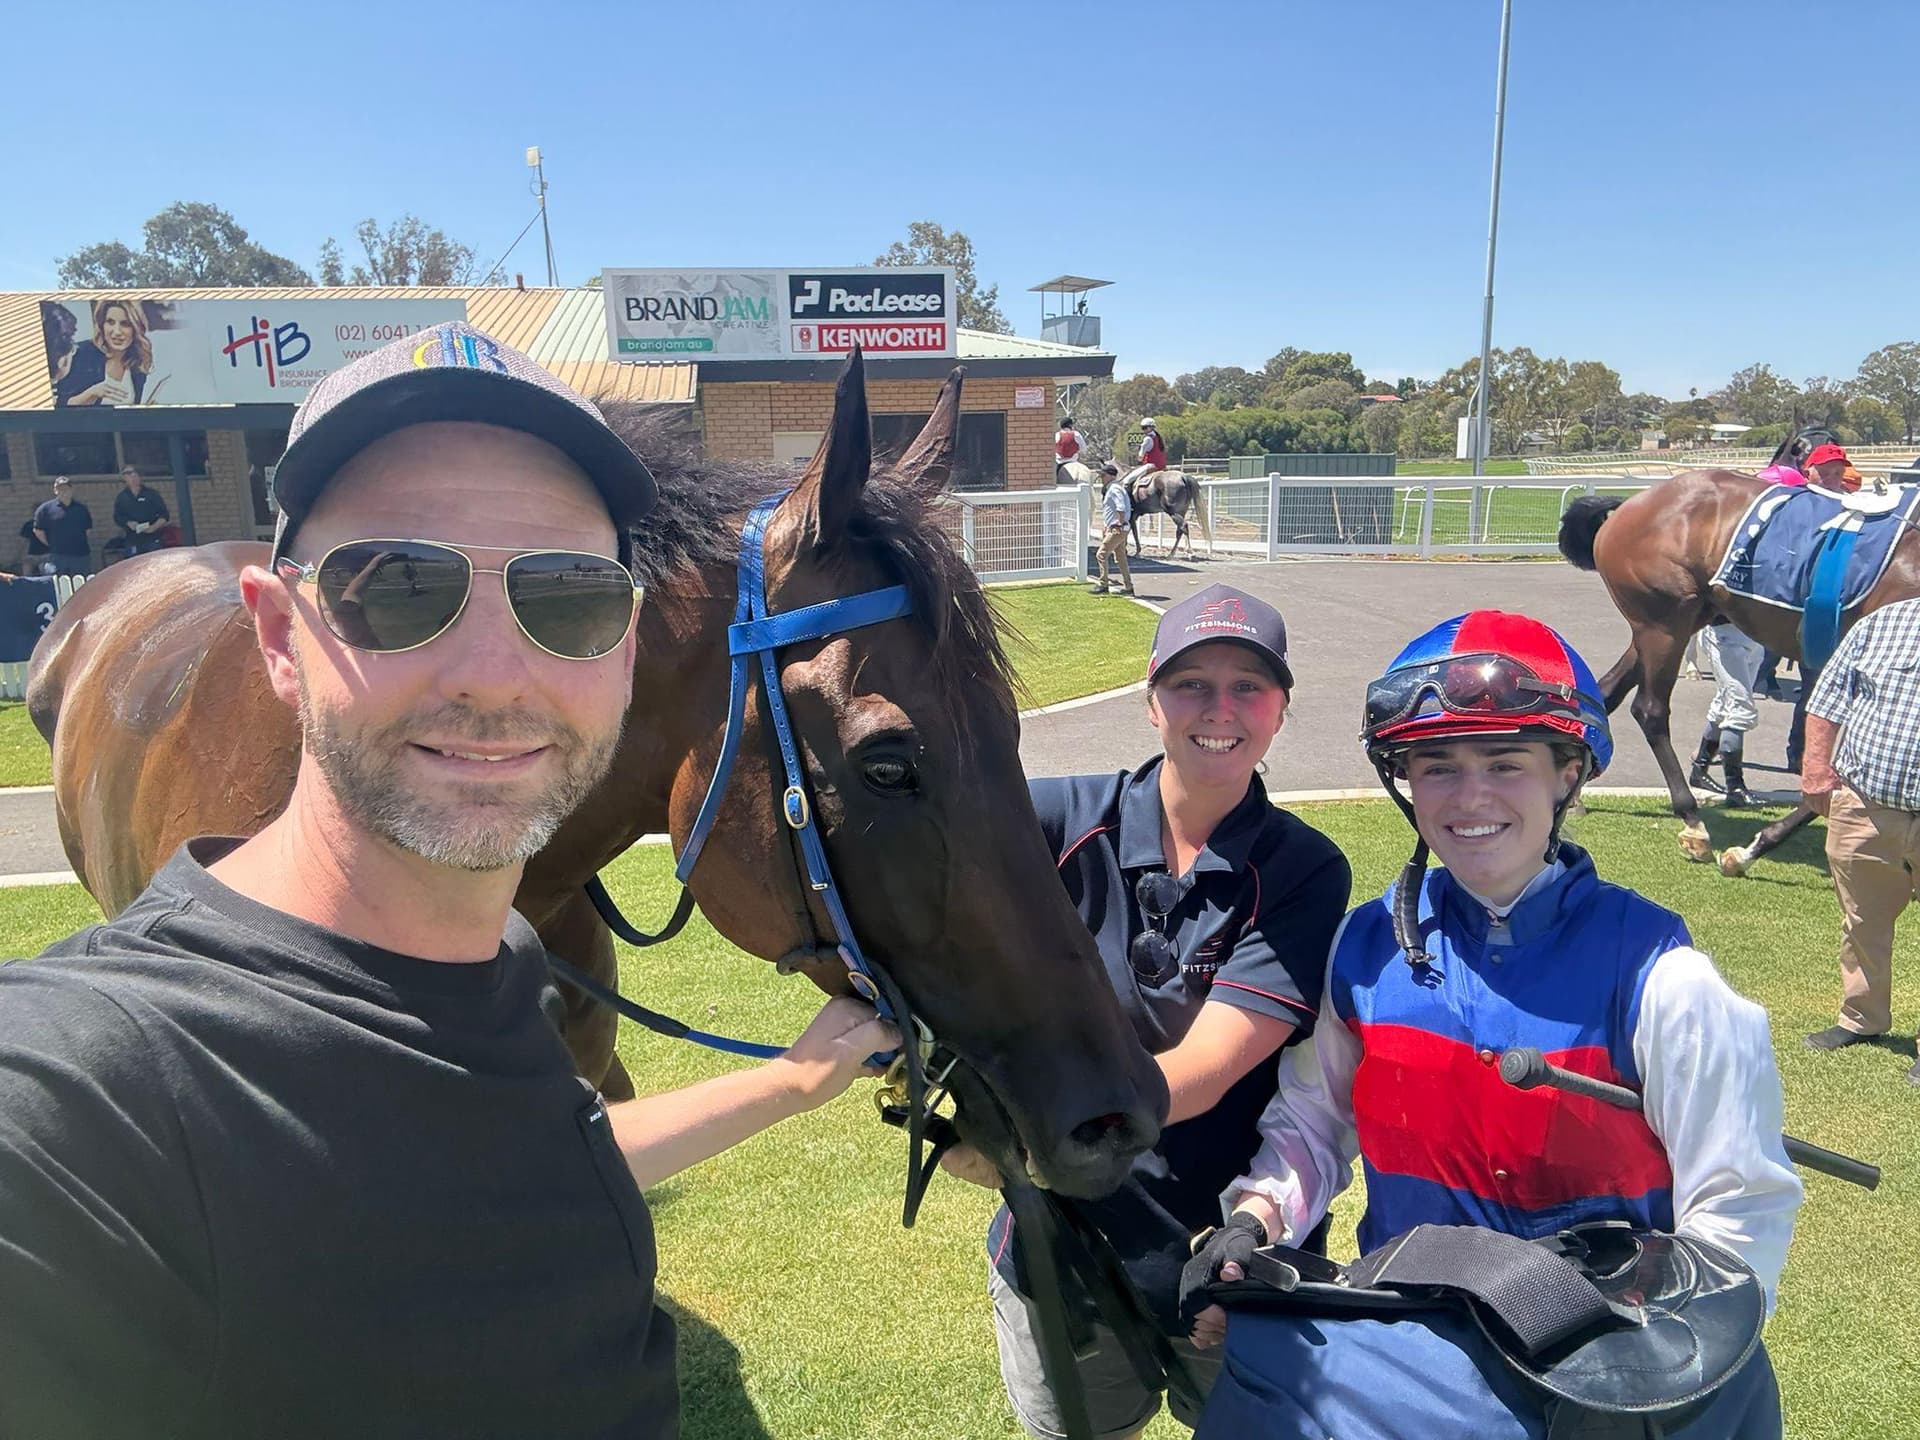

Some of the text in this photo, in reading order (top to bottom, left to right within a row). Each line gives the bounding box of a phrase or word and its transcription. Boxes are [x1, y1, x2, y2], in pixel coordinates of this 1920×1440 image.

[828, 288, 942, 312] PacLease
[335, 324, 366, 342] (02)
[372, 325, 410, 340] 6041
[822, 327, 942, 348] KENWORTH
[627, 340, 703, 351] brandjam.au
[279, 369, 327, 378] INSURANCE
